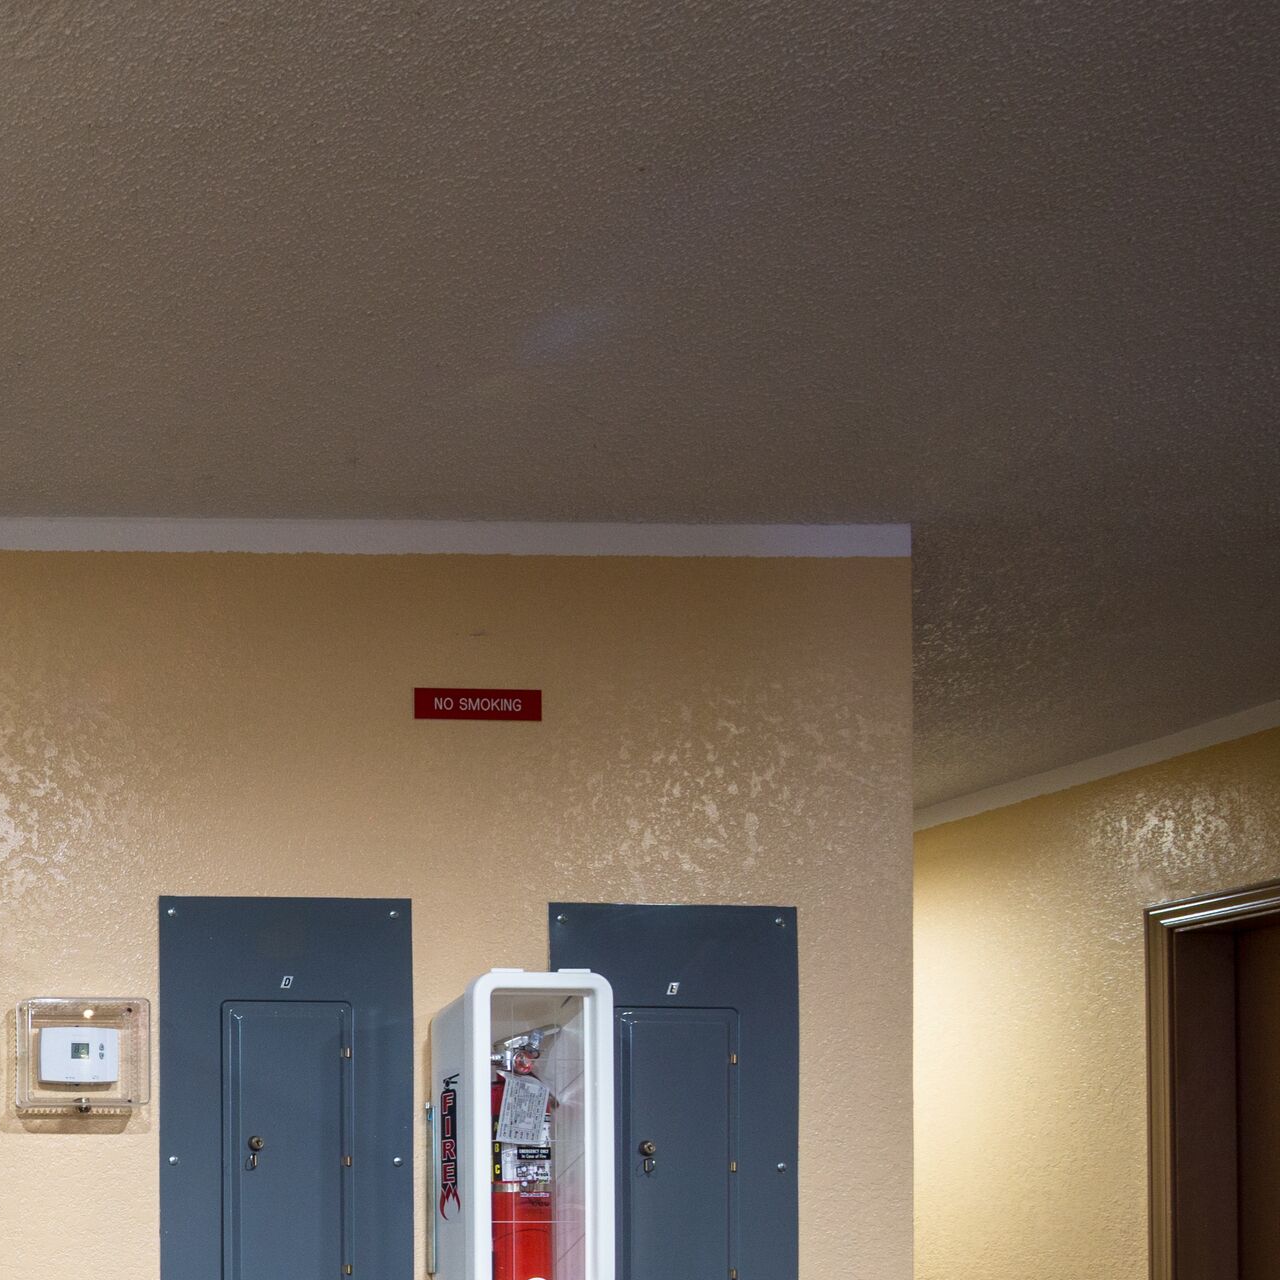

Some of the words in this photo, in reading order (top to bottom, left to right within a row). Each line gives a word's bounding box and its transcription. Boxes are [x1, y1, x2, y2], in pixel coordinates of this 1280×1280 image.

[434, 697, 454, 711] NO
[459, 698, 522, 712] SMOKING
[441, 1092, 456, 1184] FIRE
